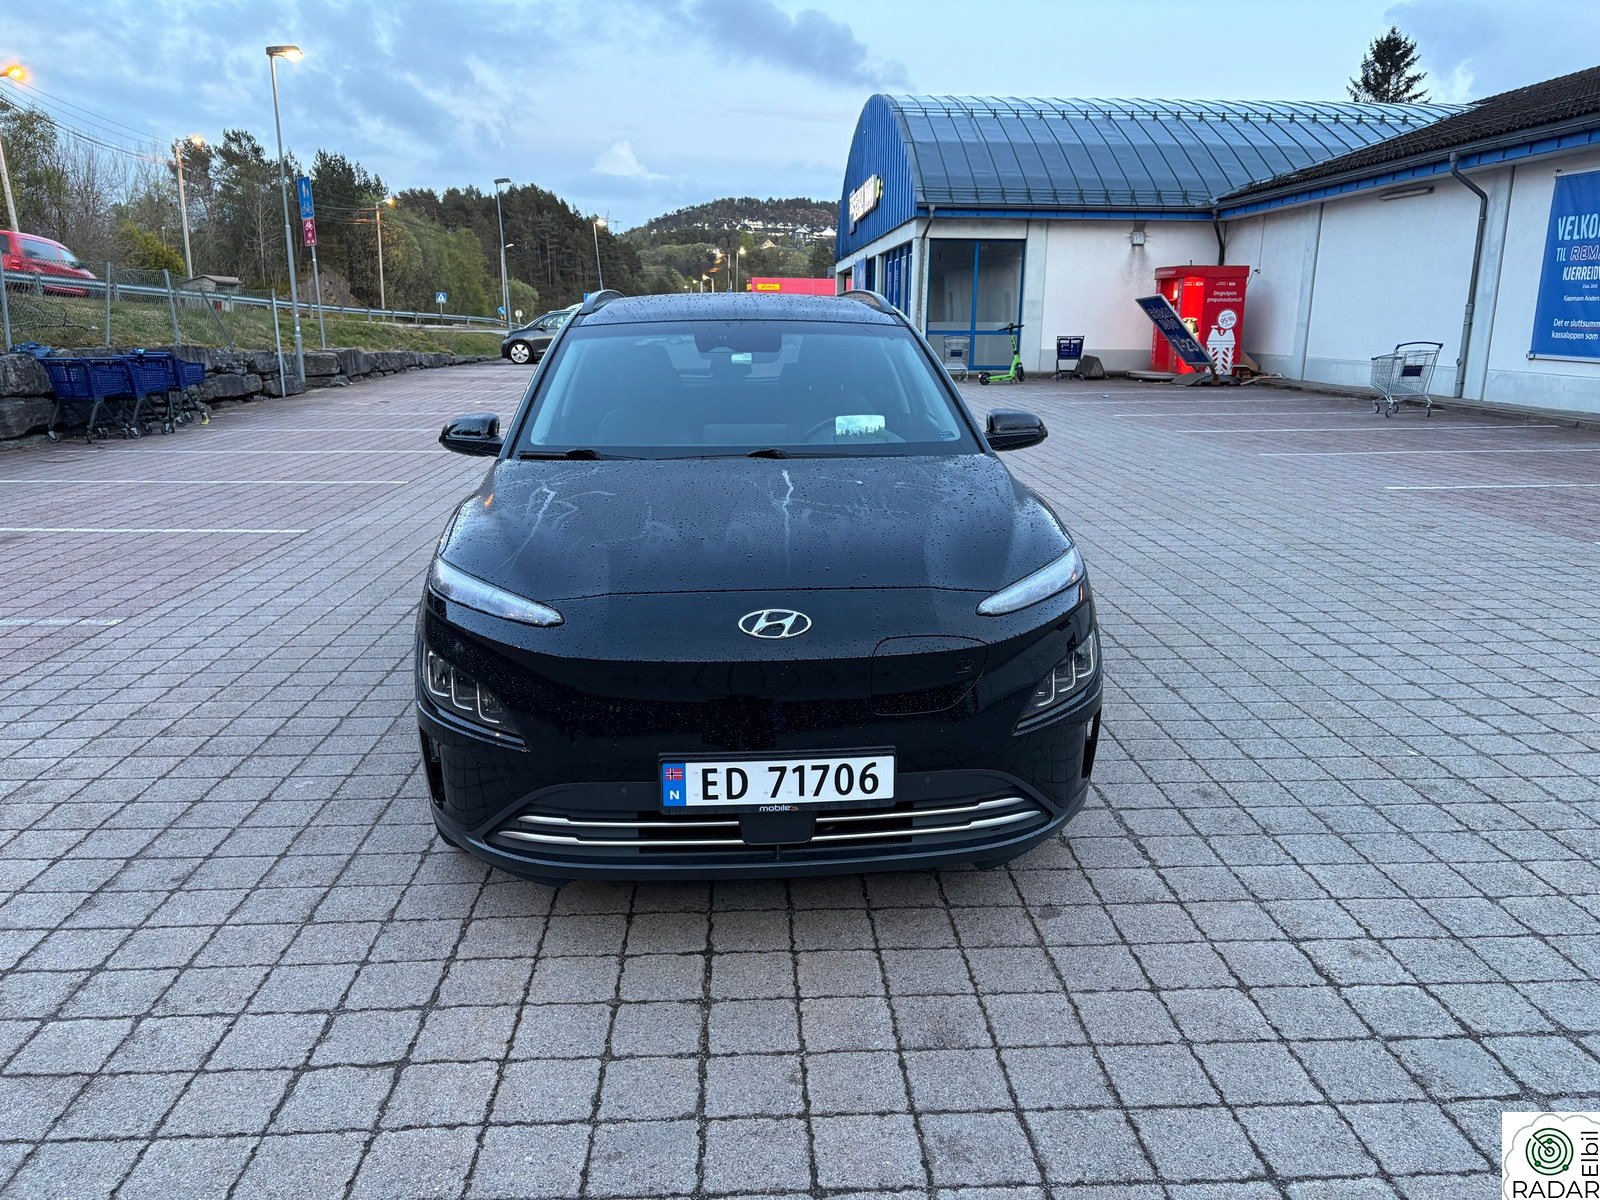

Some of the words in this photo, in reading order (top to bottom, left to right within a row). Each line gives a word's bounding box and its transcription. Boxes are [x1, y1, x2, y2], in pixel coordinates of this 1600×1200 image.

[1558, 213, 1600, 241] VELKO
[1556, 247, 1566, 262] TIL
[1570, 244, 1600, 261] REM
[1562, 265, 1600, 281] KJERREID
[701, 767, 749, 801] ED
[767, 761, 879, 799] 71706
[669, 790, 680, 800] N
